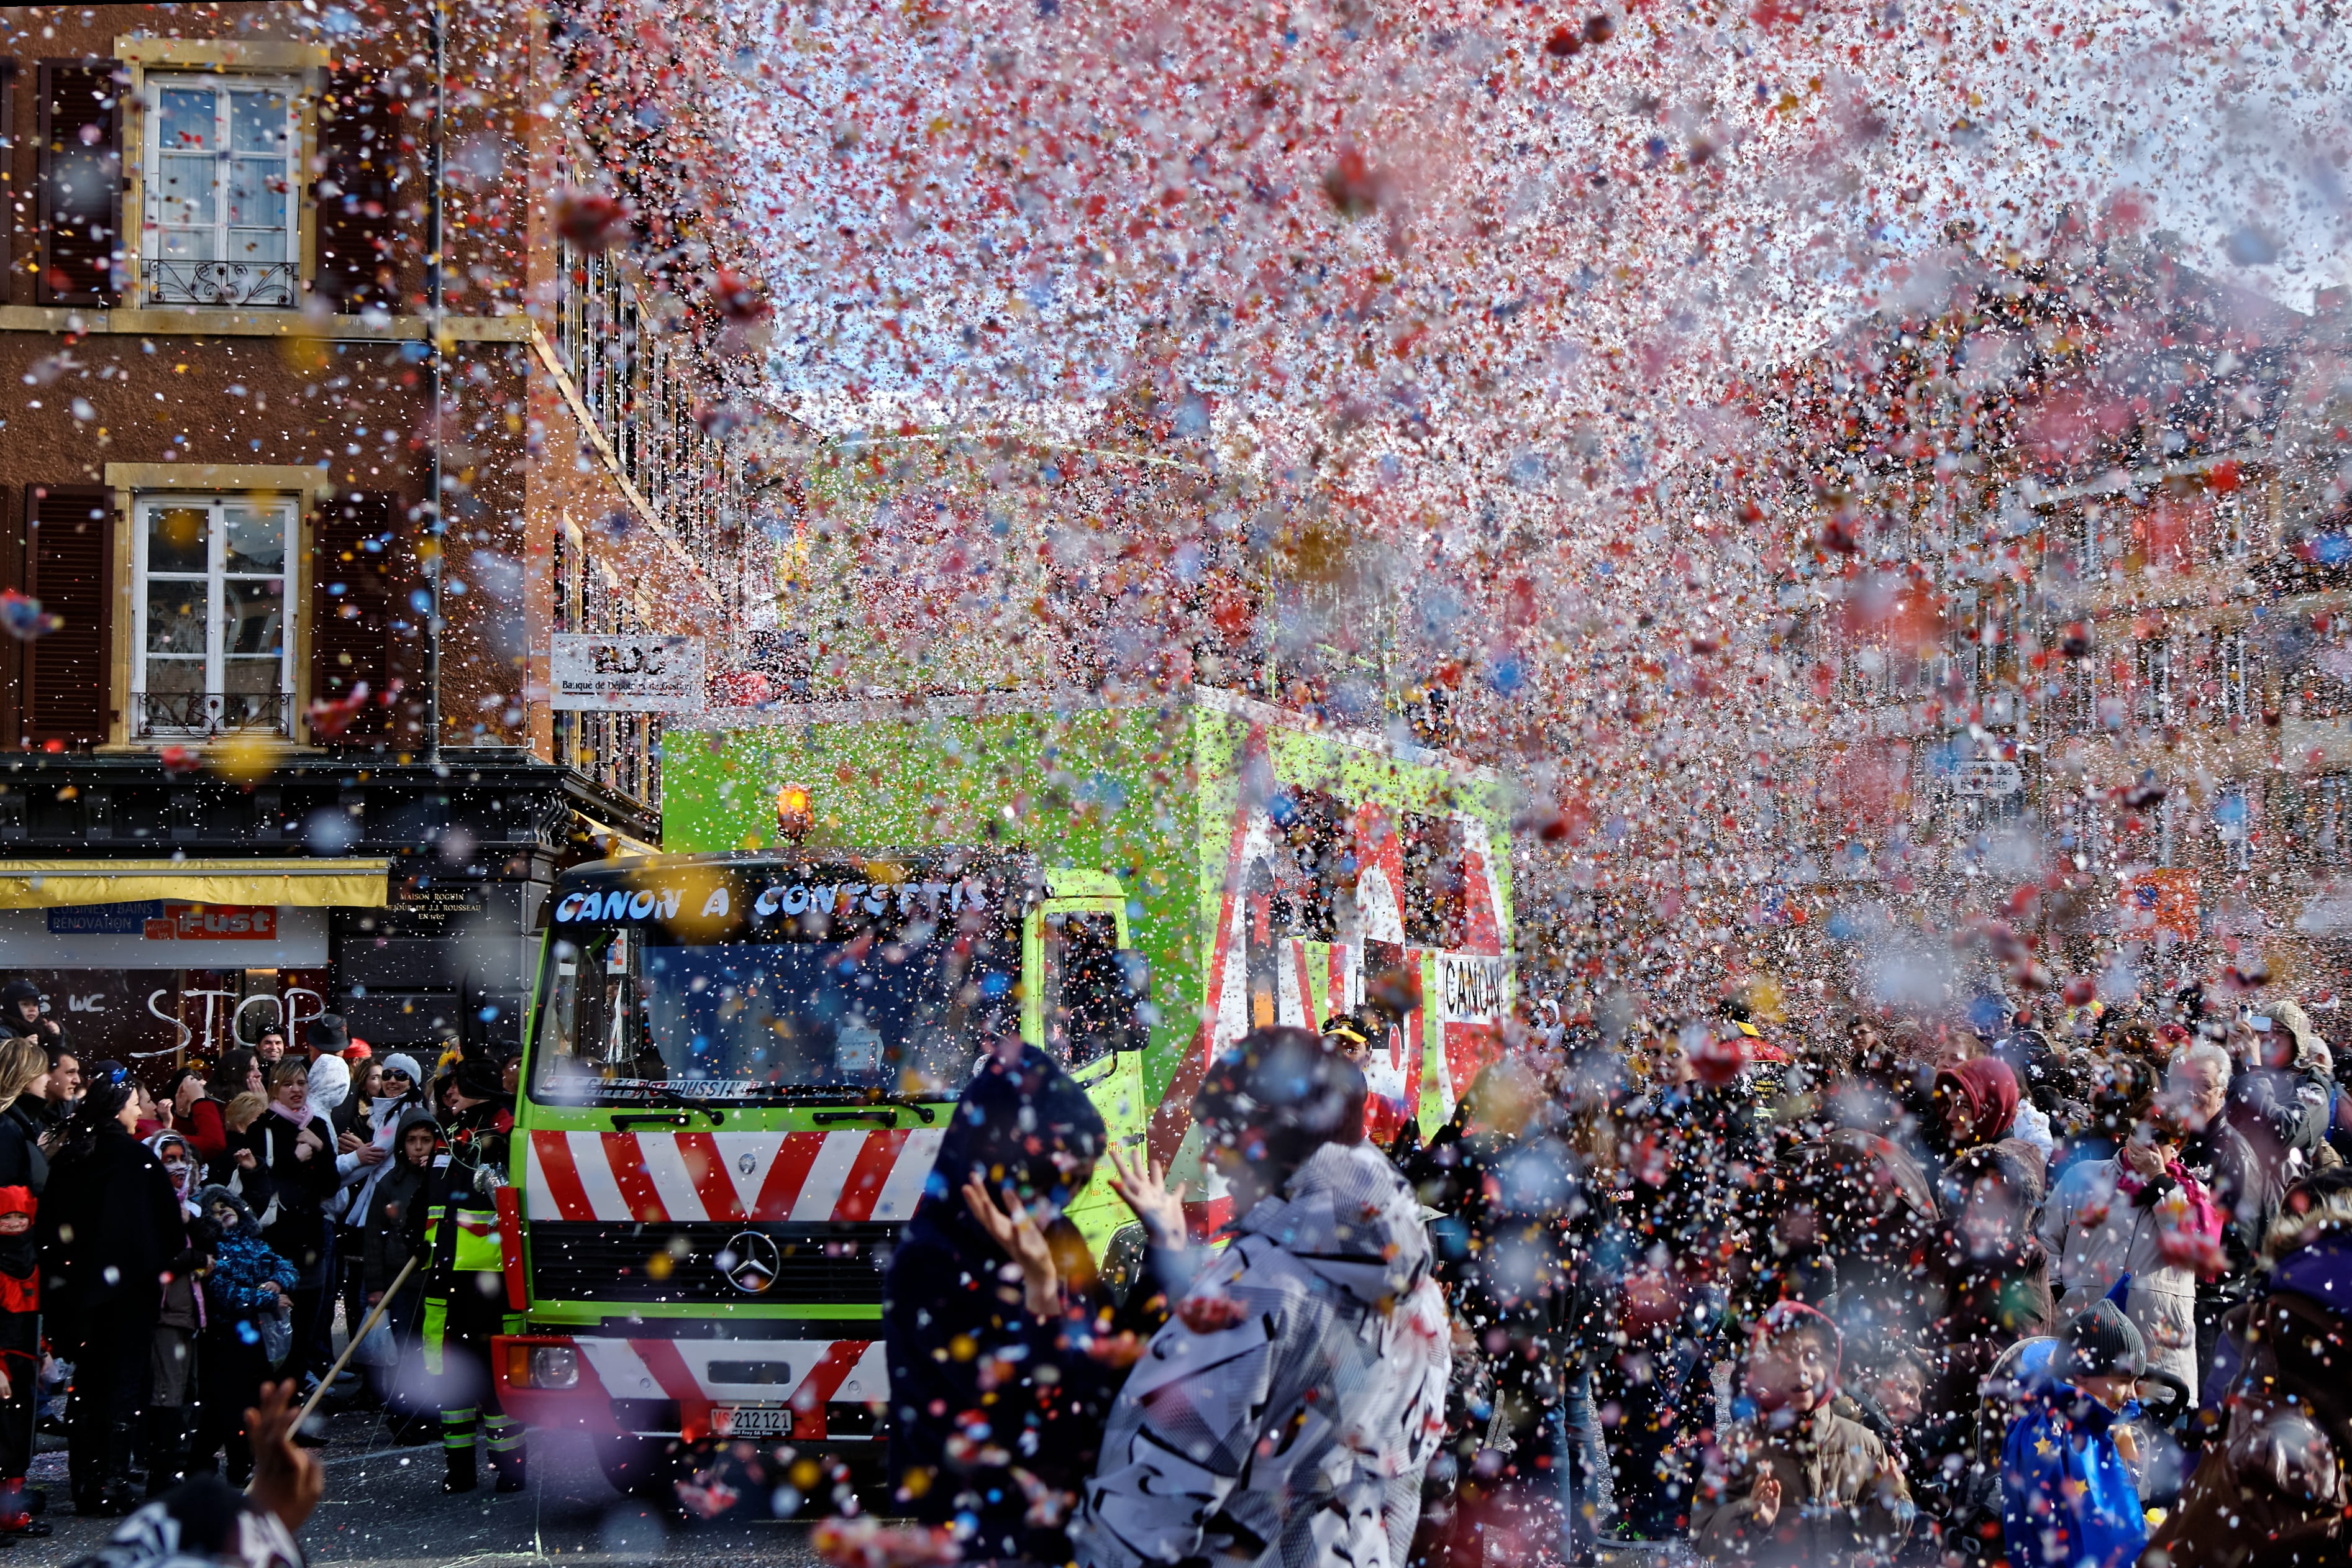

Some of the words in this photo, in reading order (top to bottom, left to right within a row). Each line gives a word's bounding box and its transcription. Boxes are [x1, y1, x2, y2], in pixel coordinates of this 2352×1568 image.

[562, 680, 593, 691] Banque
[595, 681, 605, 689] de
[399, 893, 430, 901] MAISON
[555, 889, 682, 922] CANON
[702, 887, 729, 918] A
[754, 882, 987, 916] CONFETTIS
[52, 903, 107, 914] CUISINES
[117, 902, 153, 914] BAINS
[443, 904, 481, 912] ROUSSEAU
[180, 910, 270, 932] Fust
[1446, 959, 1501, 1018] CANON
[68, 993, 106, 1013] WC
[129, 987, 326, 1058] STOP
